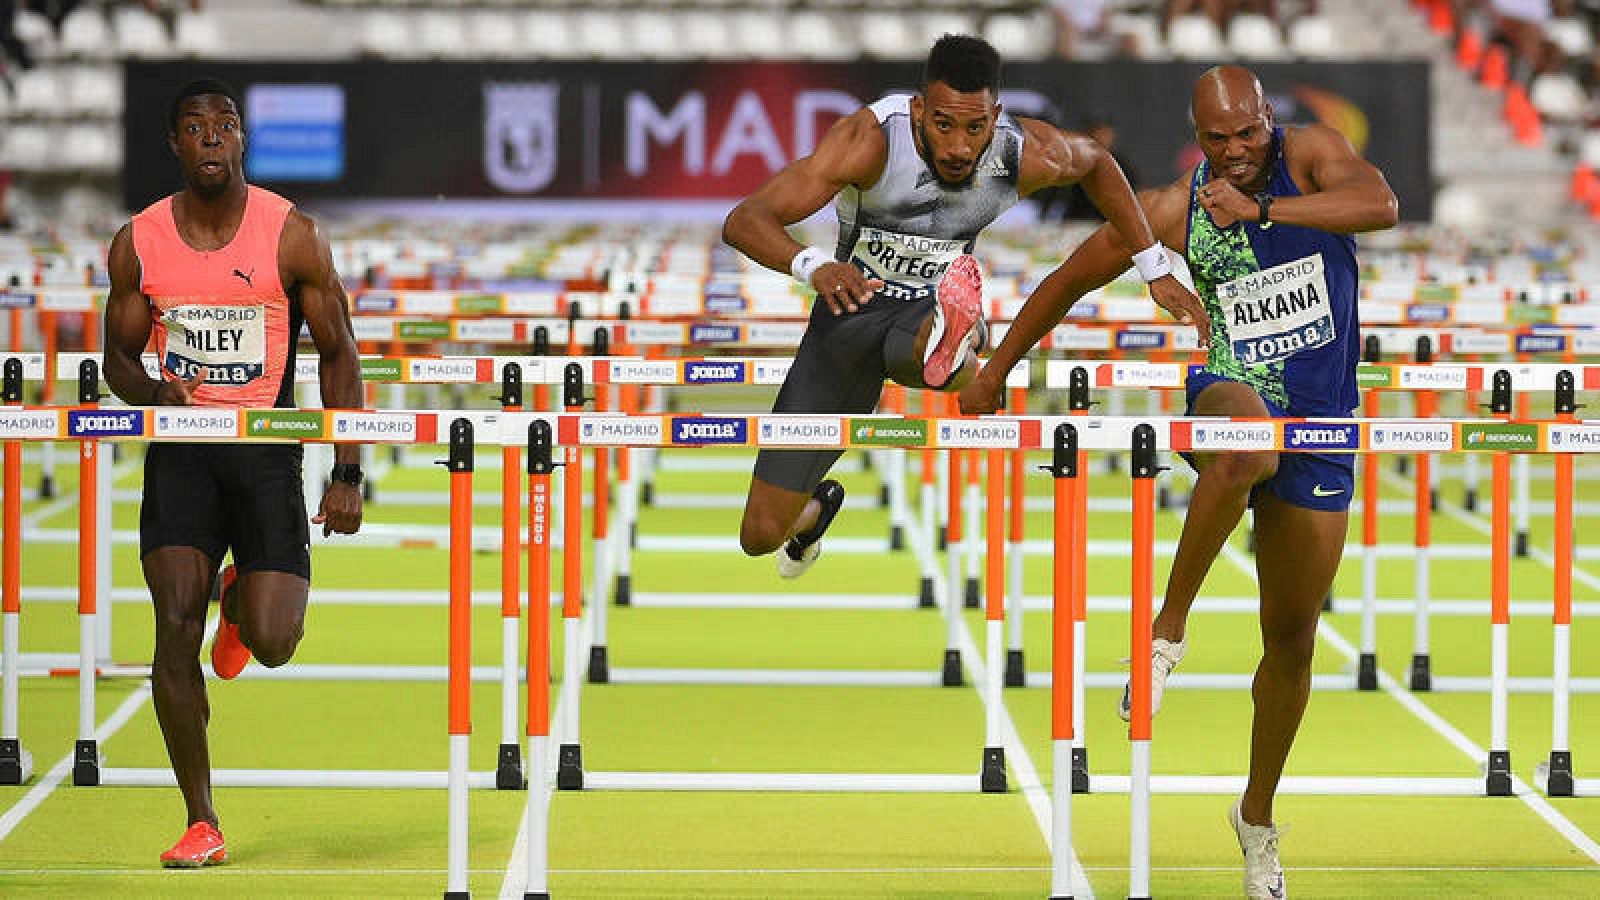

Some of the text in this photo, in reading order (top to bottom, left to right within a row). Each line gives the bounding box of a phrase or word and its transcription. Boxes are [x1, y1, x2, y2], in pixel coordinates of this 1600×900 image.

[1244, 261, 1315, 293] MADRID
[1233, 281, 1321, 327] ALKANA
[187, 309, 257, 321] MADRID
[185, 329, 243, 352] RILEY
[177, 416, 235, 430] MADRID
[355, 420, 413, 433] MADRID
[601, 424, 659, 437] MADRID
[780, 424, 839, 437] MADRID
[958, 427, 1017, 440] MADRID
[1213, 429, 1271, 442] MADRID
[1391, 431, 1449, 443] MADRID
